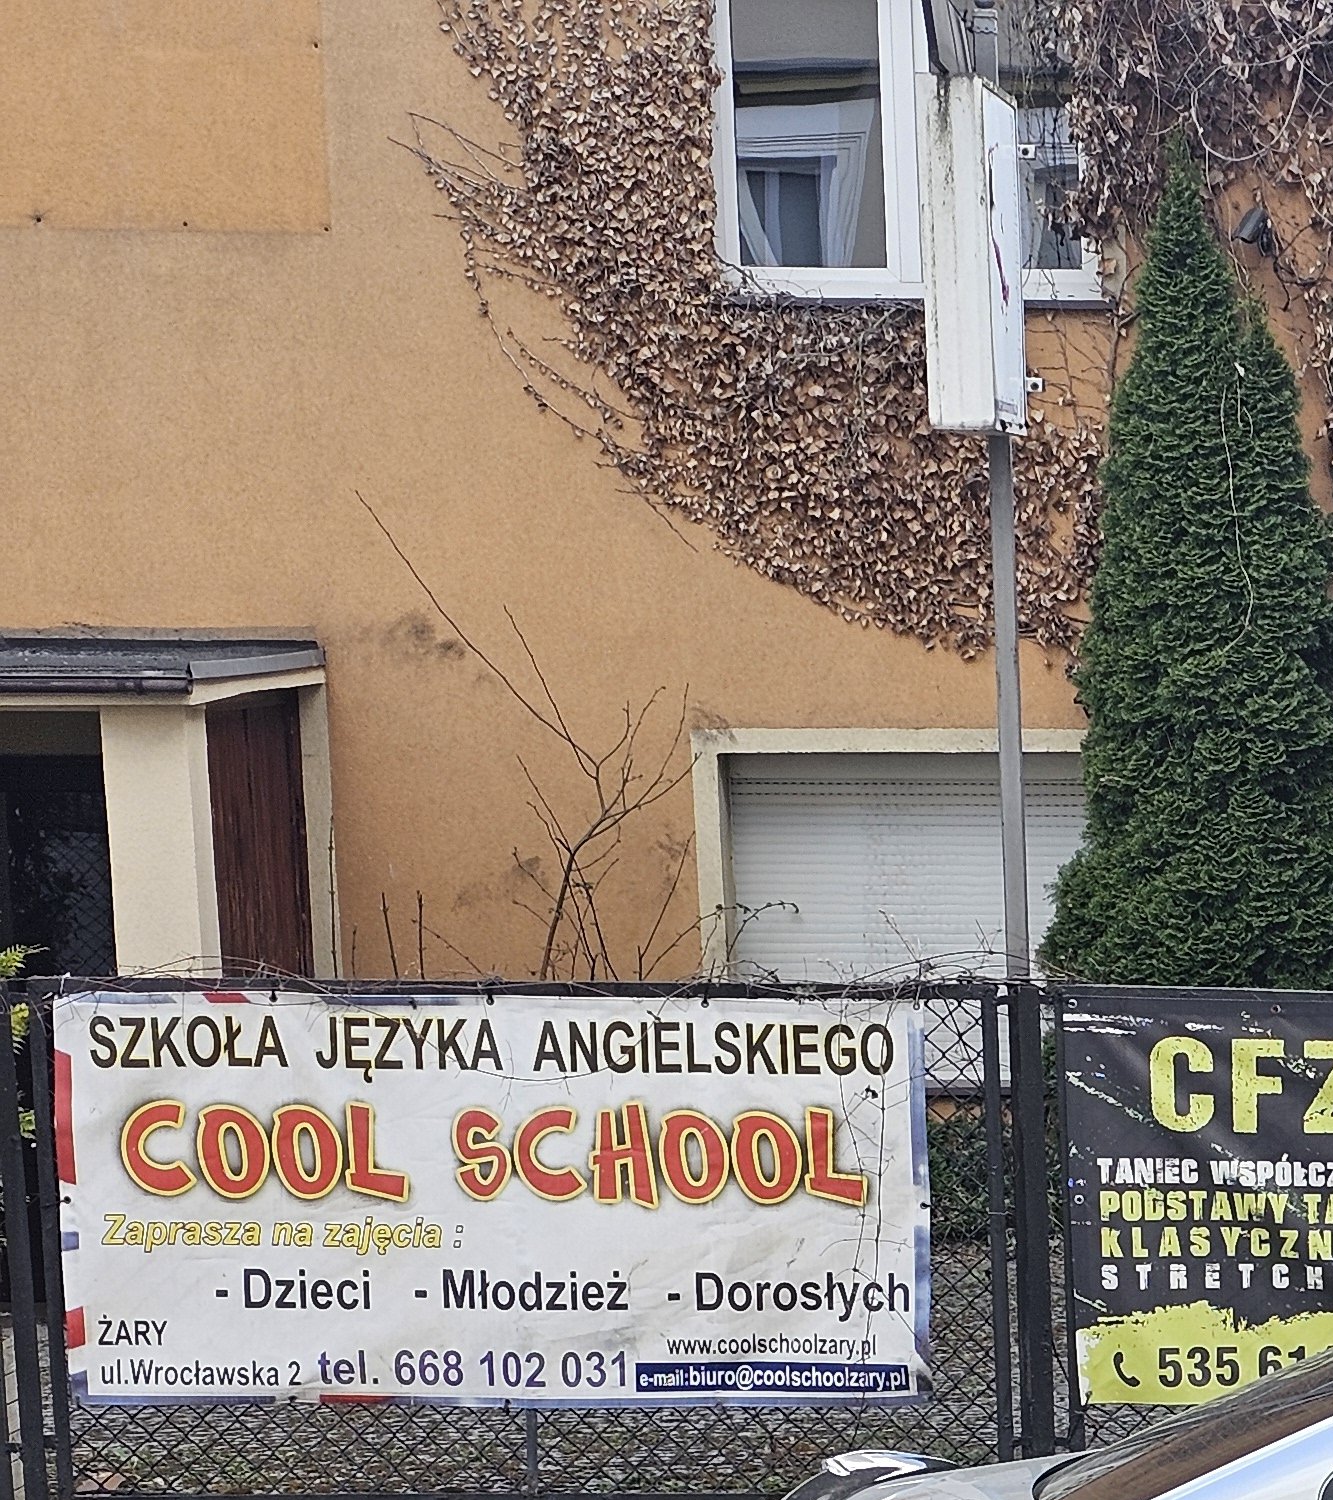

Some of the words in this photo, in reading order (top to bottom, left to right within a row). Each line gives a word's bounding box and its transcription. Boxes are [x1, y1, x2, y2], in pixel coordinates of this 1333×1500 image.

[89, 1015, 288, 1068] SZKOŁA
[316, 1016, 503, 1083] JĘZYKA
[533, 1020, 894, 1076] ANGIELSKIEGO
[121, 1099, 409, 1202] COOL
[452, 1100, 868, 1209] SCHOOL
[1097, 1157, 1199, 1185] TANIEC
[1100, 1188, 1289, 1224] PODSTAWY
[101, 1214, 261, 1252] Zaprasza
[271, 1221, 313, 1247] na
[98, 1314, 168, 1346] ŻARY
[666, 1333, 876, 1360] www.coolschoolzary.pl
[101, 1358, 279, 1386] ul.Wrocławska
[288, 1361, 302, 1386] 2
[317, 1349, 379, 1385] tel.
[394, 1350, 463, 1387] 668
[479, 1350, 546, 1388] 102
[561, 1350, 627, 1388] 031
[1158, 1346, 1240, 1387] 535
[1259, 1345, 1333, 1378] 61
